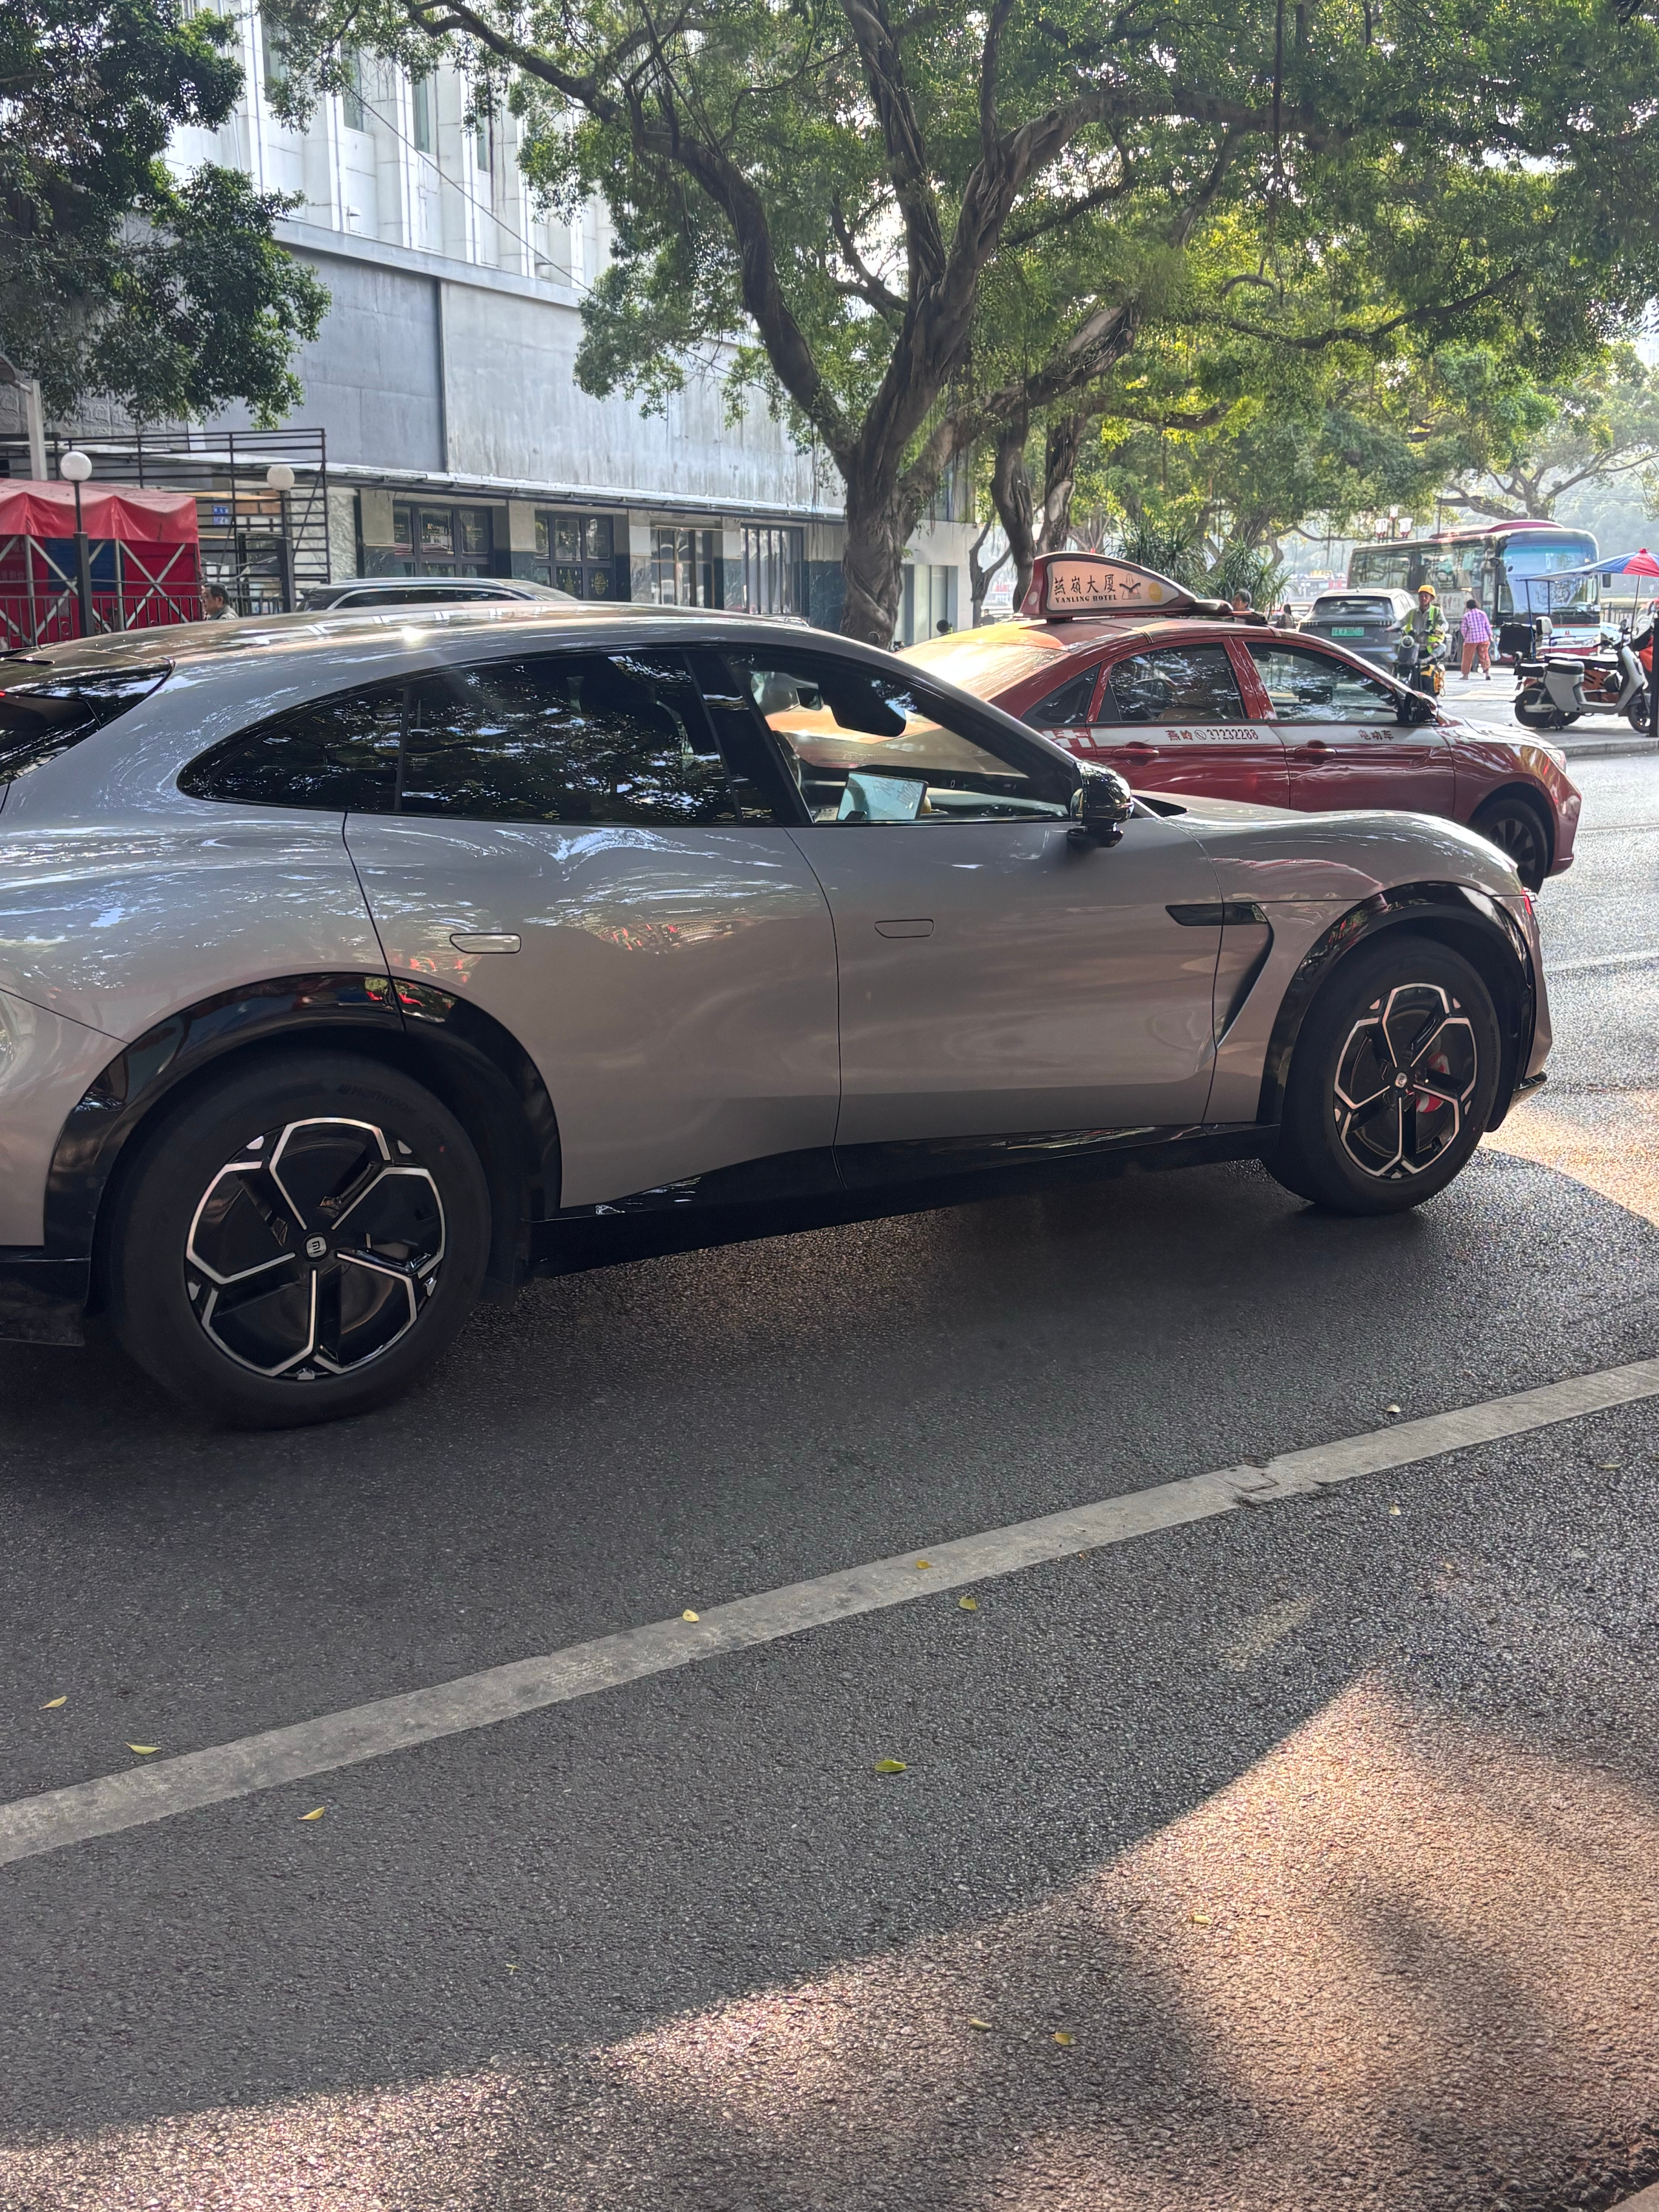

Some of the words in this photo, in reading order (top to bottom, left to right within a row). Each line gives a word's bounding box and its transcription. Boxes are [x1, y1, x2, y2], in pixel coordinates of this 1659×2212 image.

[1207, 729, 1259, 740] 37232288
[1358, 729, 1394, 740] 电动车
